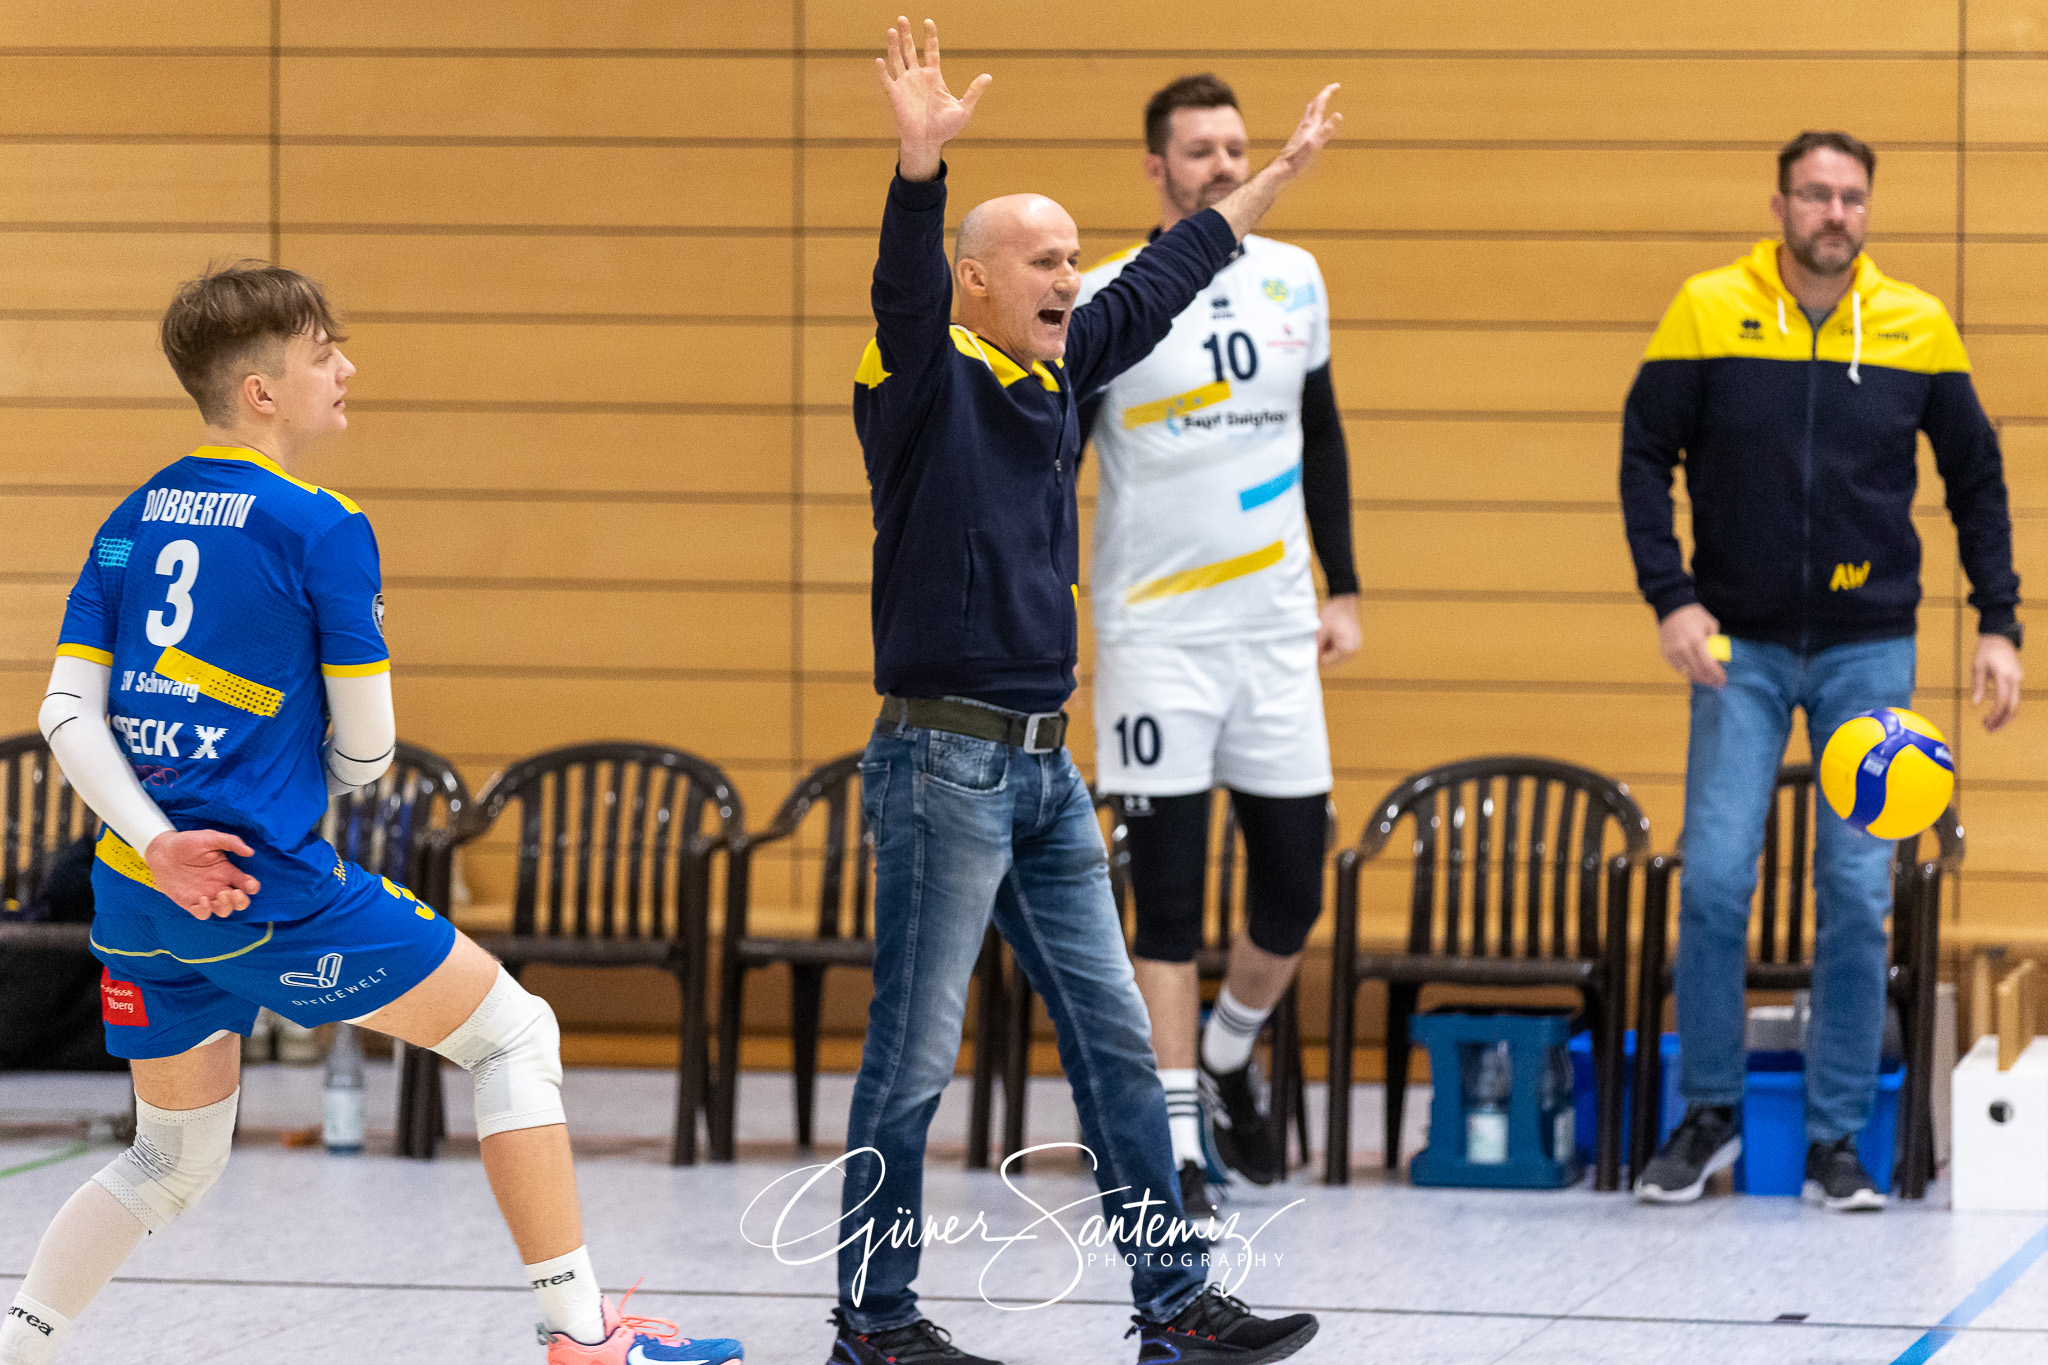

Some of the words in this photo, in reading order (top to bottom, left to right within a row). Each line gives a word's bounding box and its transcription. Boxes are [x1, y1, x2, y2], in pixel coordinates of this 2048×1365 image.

[1203, 331, 1258, 383] 10
[141, 487, 257, 529] DOBBERTIN
[145, 539, 200, 648] 3
[135, 671, 200, 704] Schwaig
[1114, 715, 1161, 767] 10
